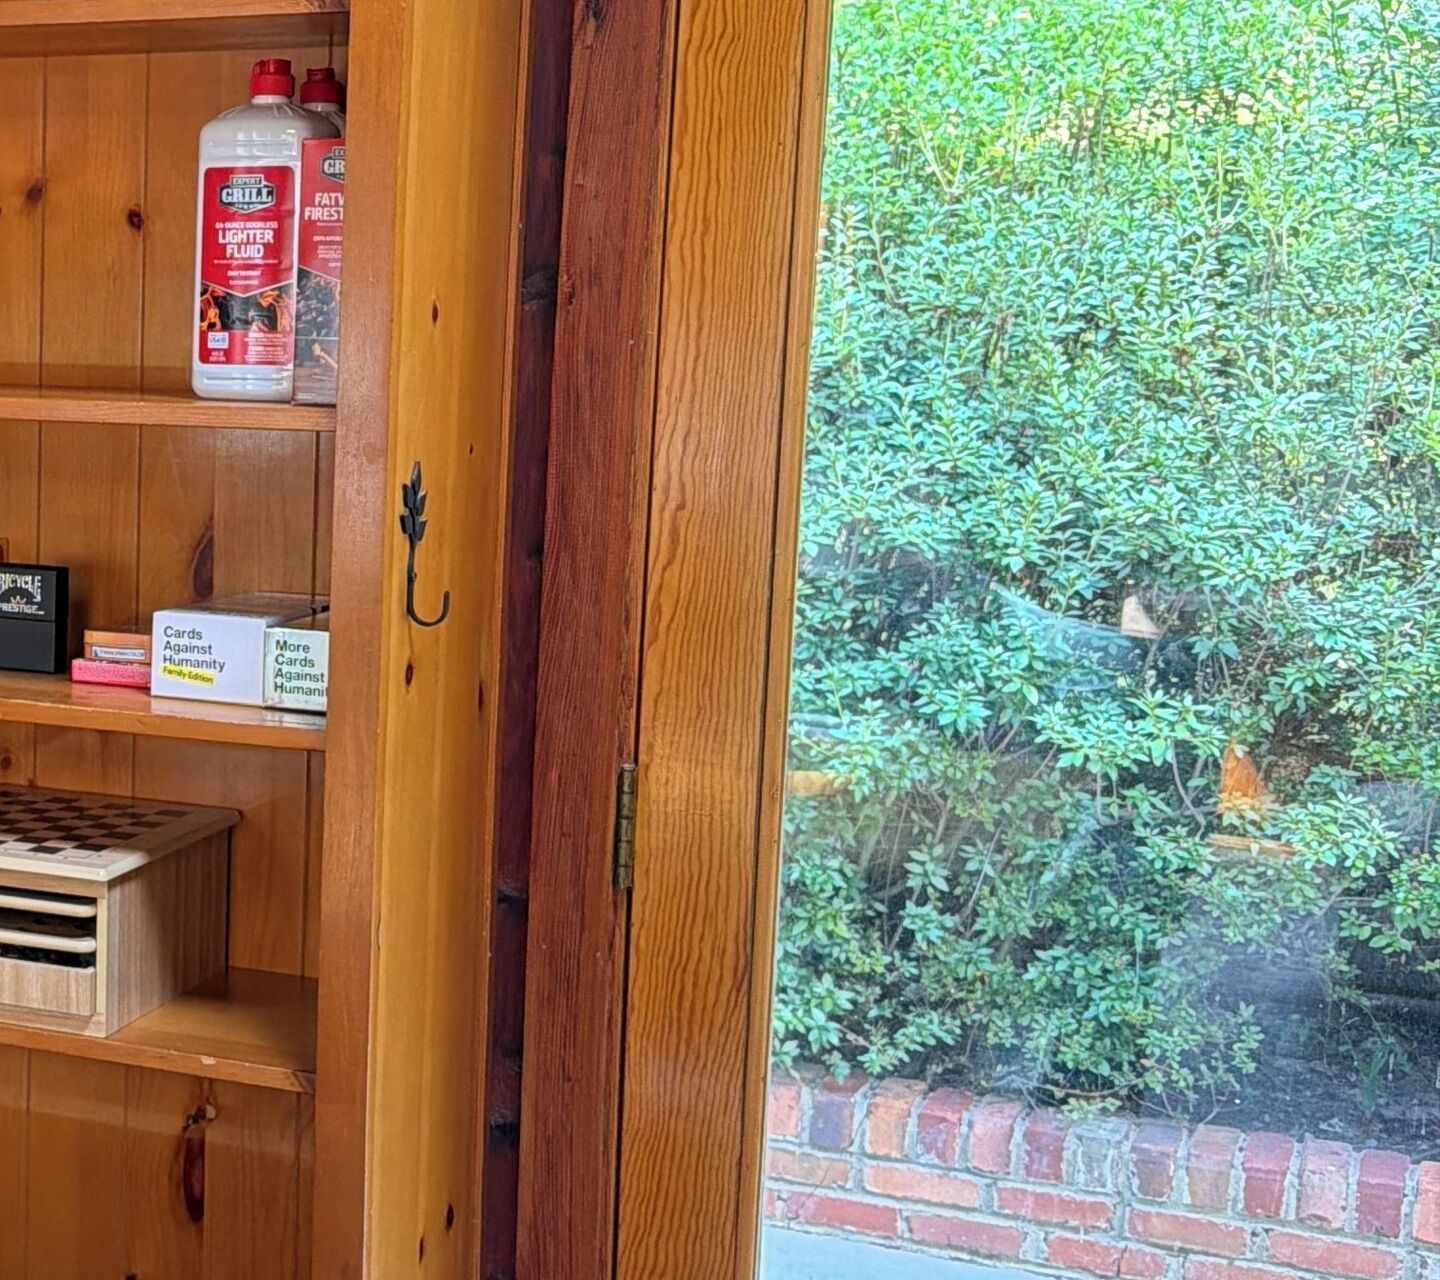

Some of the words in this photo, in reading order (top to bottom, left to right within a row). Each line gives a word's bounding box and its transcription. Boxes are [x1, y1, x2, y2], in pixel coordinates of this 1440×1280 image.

[232, 177, 261, 186] EXPERT
[221, 187, 272, 203] GRILL
[218, 229, 274, 244] LIGHTER
[226, 244, 264, 258] FLUID
[163, 626, 203, 640] Cards
[163, 640, 213, 656] Against
[275, 639, 311, 654] More
[163, 655, 226, 673] Humanity
[275, 654, 315, 669] Cards
[163, 666, 187, 680] Family
[187, 671, 214, 684] Edition
[274, 668, 325, 683] Against
